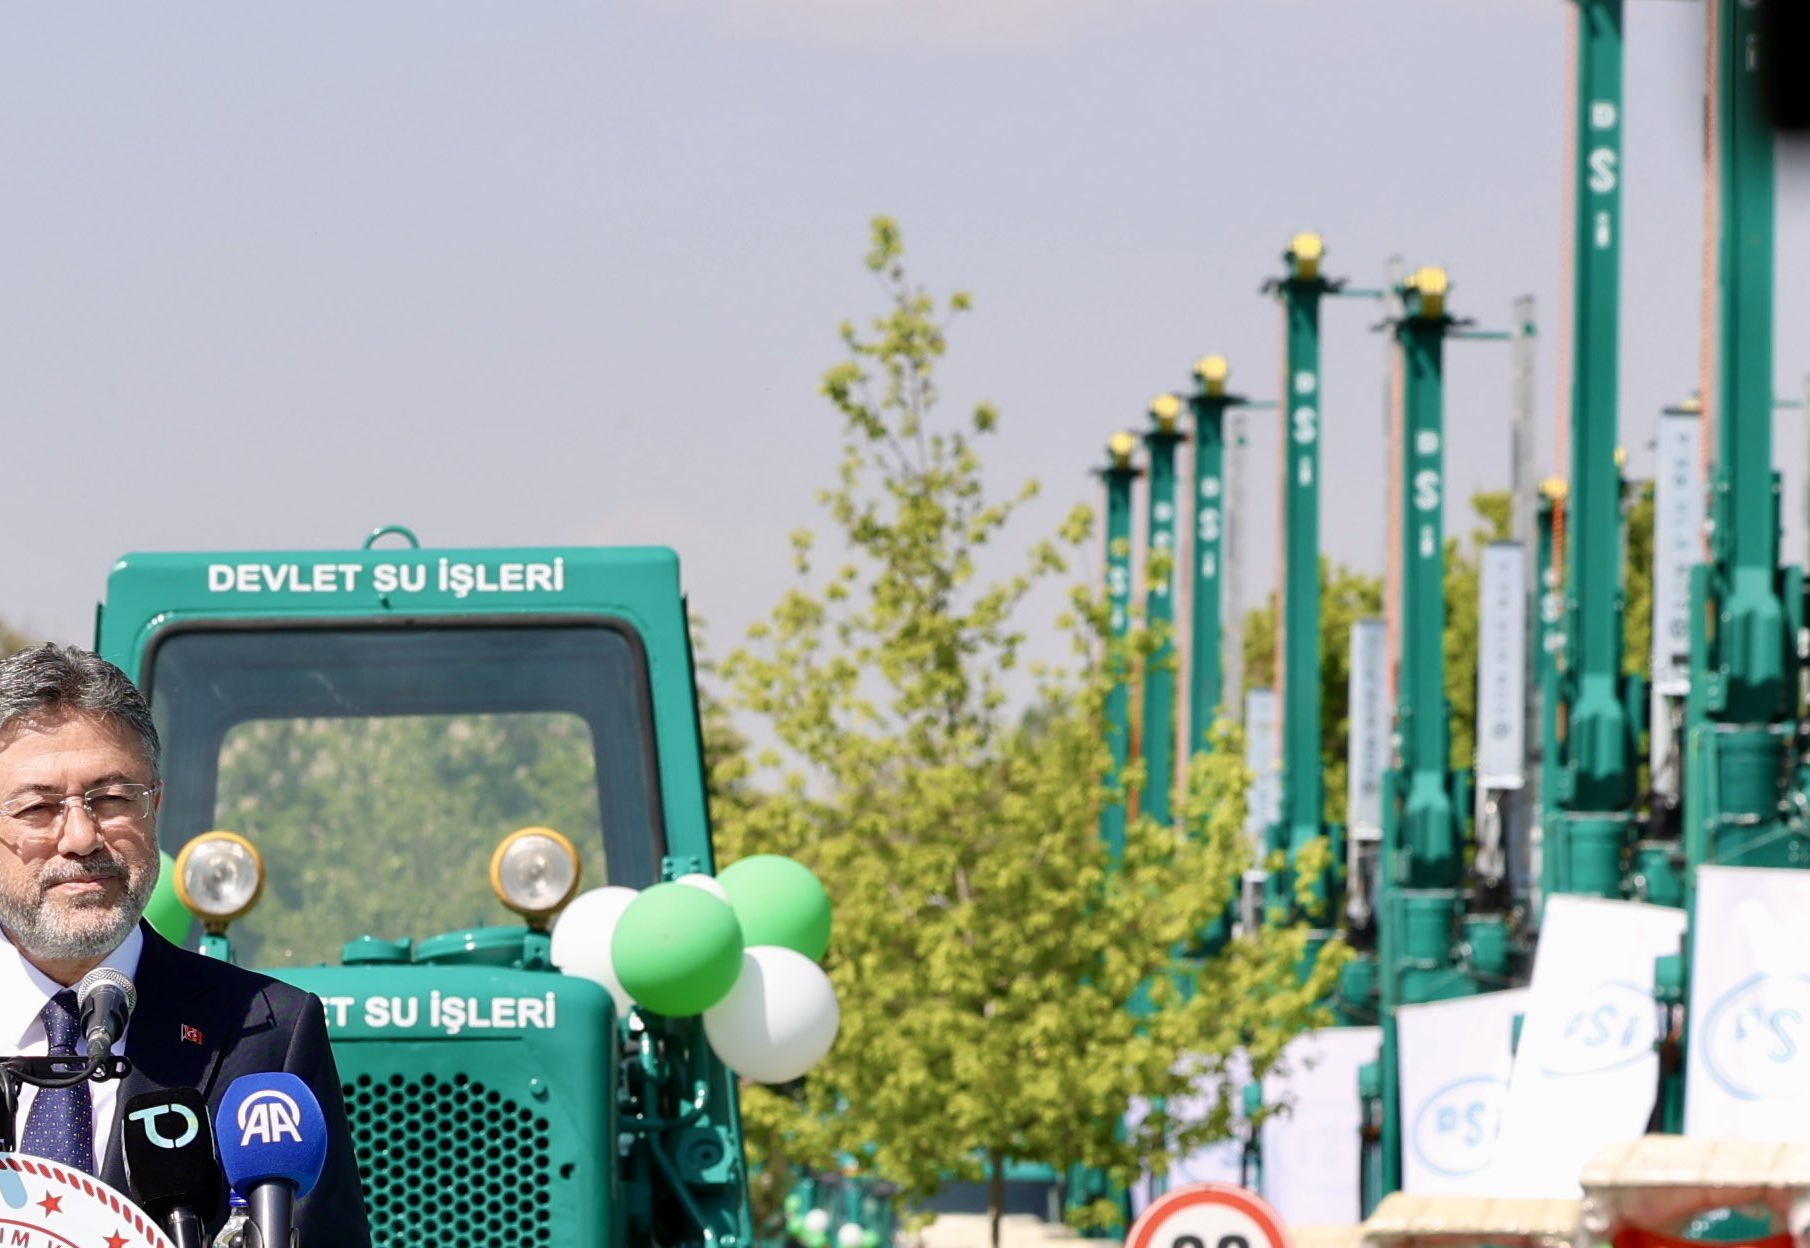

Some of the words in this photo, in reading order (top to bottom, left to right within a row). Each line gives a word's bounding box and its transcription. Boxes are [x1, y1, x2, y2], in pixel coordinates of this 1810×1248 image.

[208, 564, 362, 592] DEVLET
[373, 563, 426, 592] SU
[438, 557, 564, 598] İŞLERİ
[364, 996, 419, 1028] SU
[430, 990, 556, 1035] İŞLERİ
[239, 1100, 303, 1147] AA
